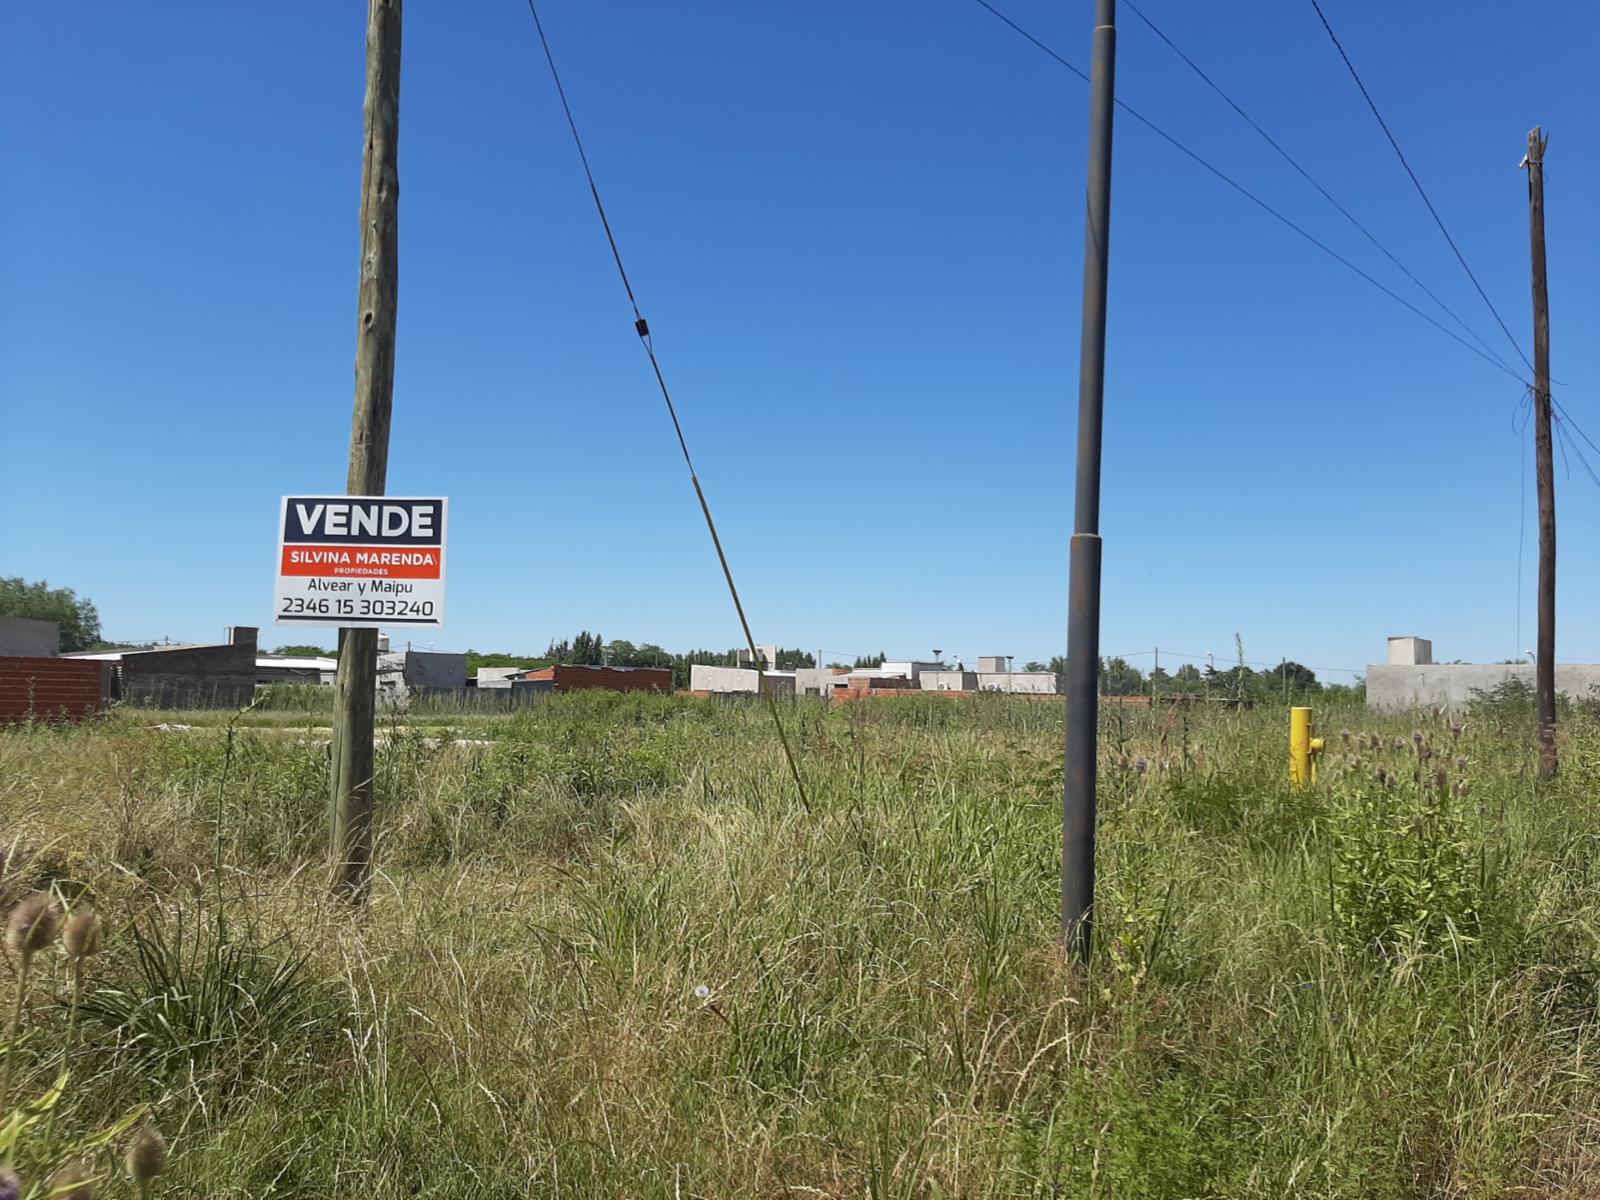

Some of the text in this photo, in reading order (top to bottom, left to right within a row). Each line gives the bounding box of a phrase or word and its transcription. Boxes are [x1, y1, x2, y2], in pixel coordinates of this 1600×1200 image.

[296, 504, 434, 537] VENDE
[290, 551, 434, 566] SILVINA MARENDA
[334, 567, 388, 575] PROPIEDADES
[307, 578, 413, 597] Alvear y Maipu
[282, 597, 434, 616] 2346 15 303240
